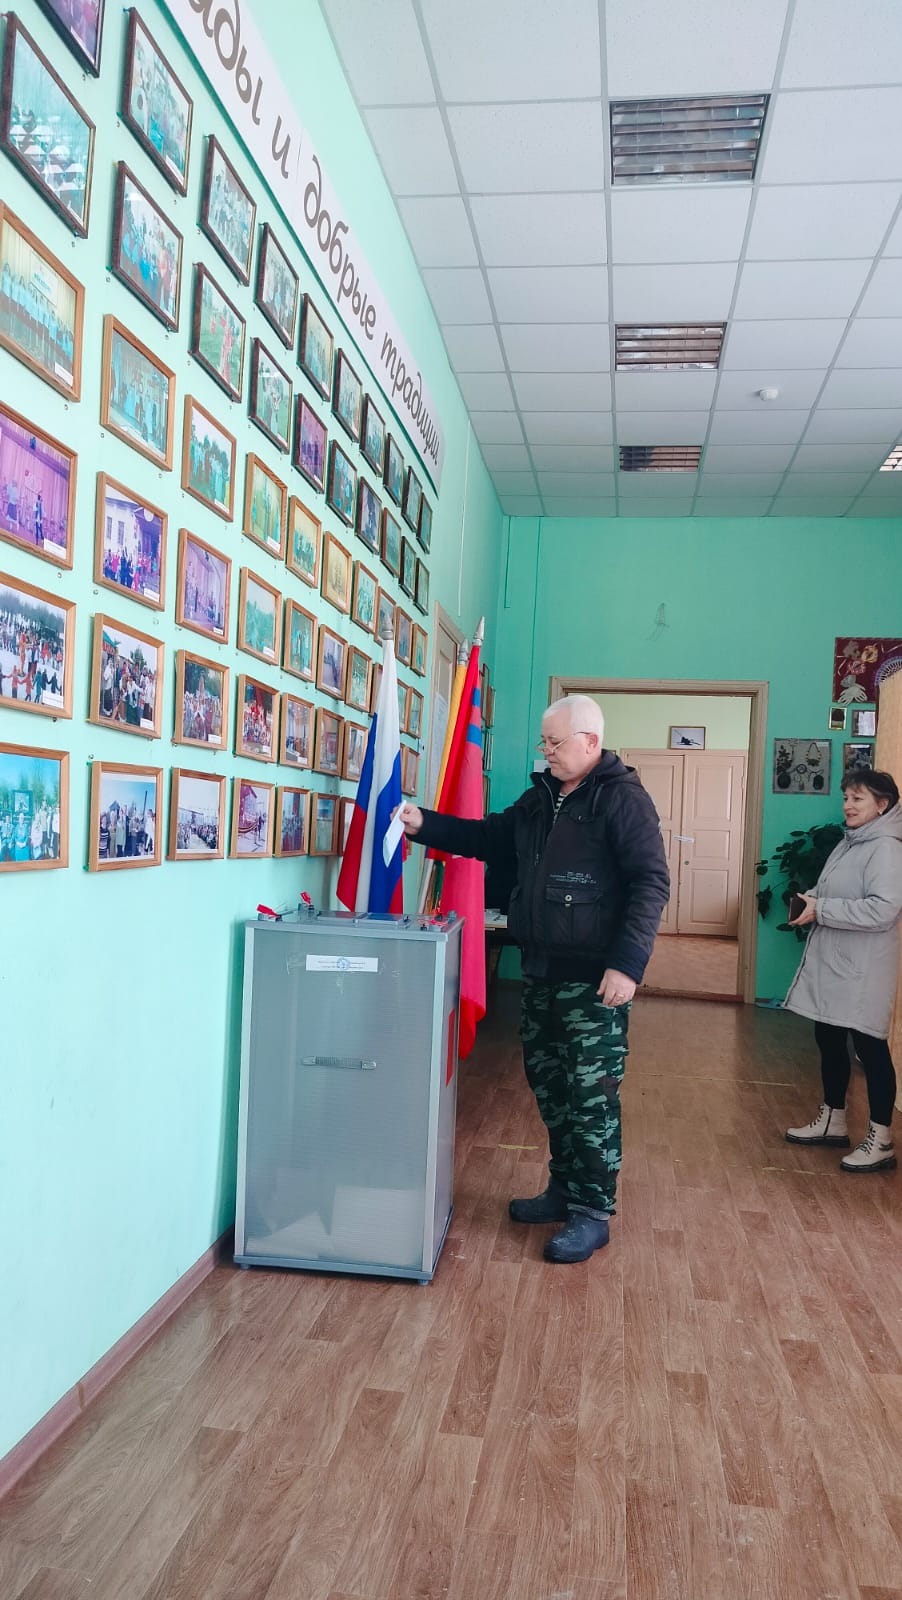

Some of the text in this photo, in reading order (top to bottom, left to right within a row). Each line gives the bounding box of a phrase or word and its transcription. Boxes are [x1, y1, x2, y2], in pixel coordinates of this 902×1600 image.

[272, 115, 291, 179] и
[303, 154, 376, 340] добрые
[381, 332, 439, 466] традиции
